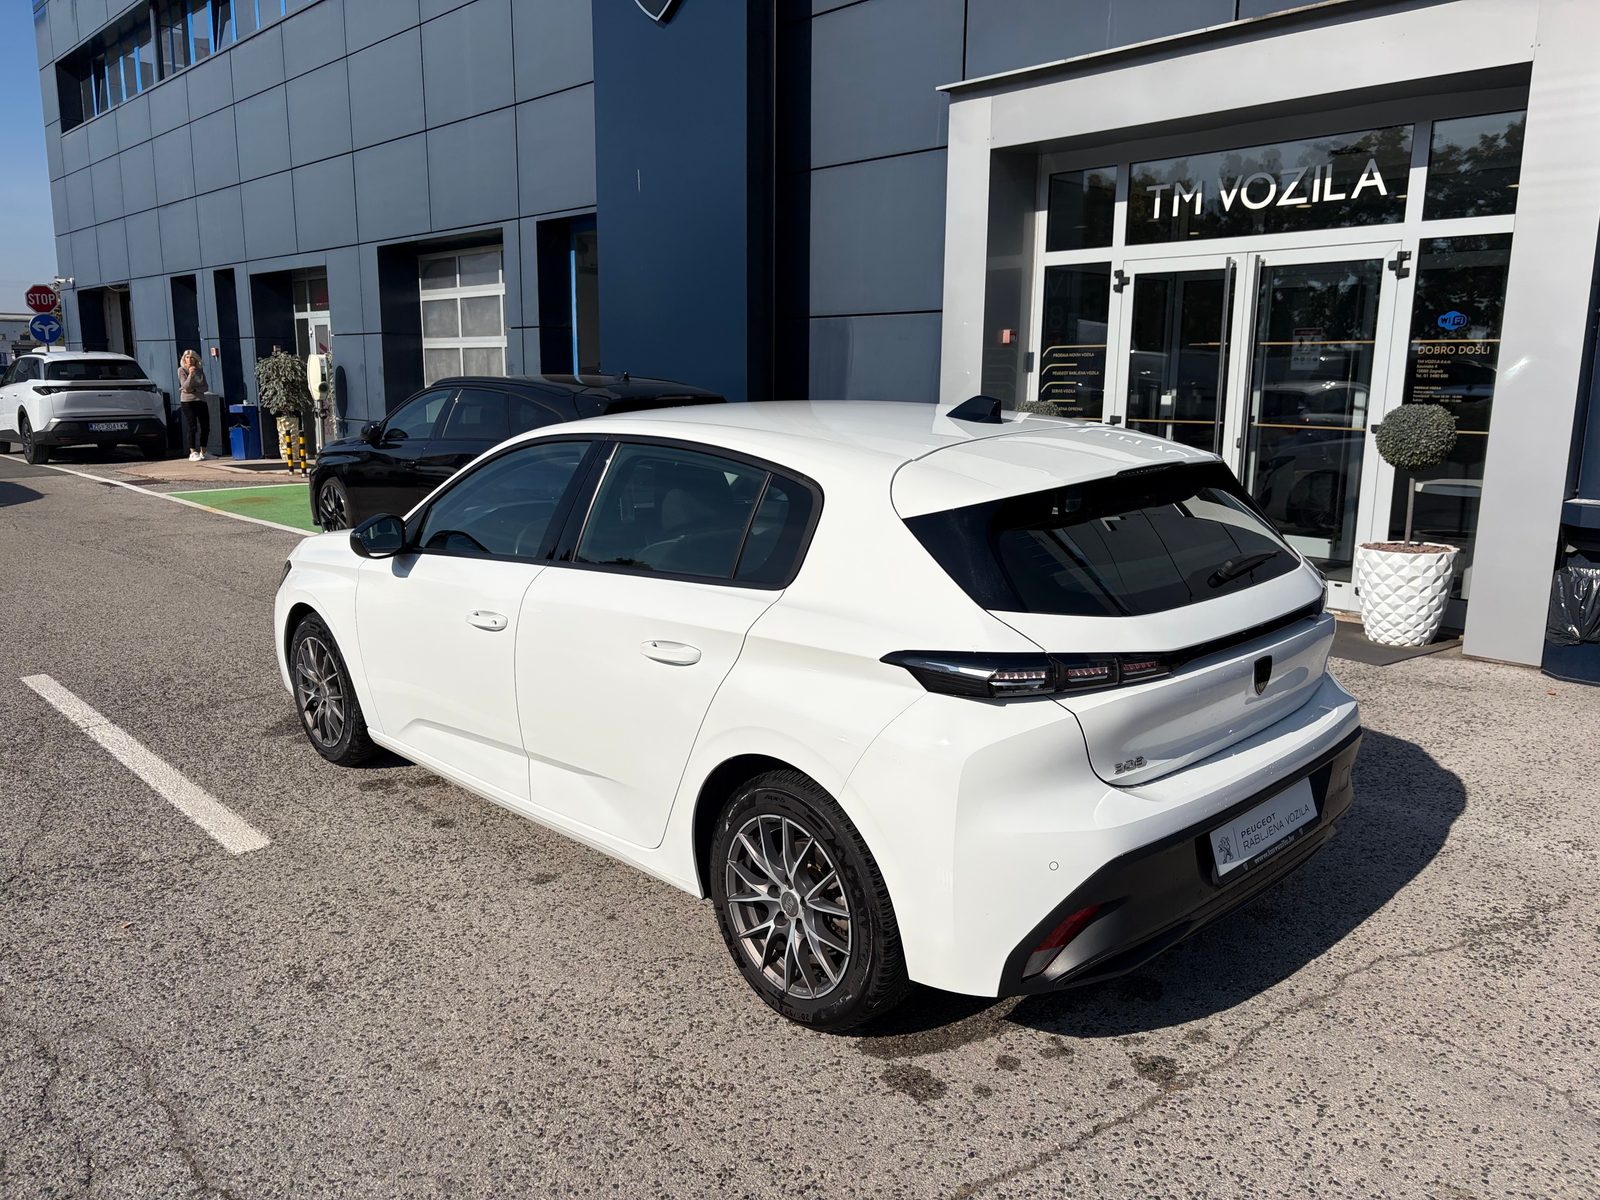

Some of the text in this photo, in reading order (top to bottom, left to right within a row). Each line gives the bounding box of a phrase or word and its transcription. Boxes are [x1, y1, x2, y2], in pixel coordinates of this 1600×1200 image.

[1146, 158, 1388, 219] TM VOZILA
[28, 294, 55, 305] STOP
[1417, 344, 1490, 355] DOBRO DOŠLI
[1114, 756, 1147, 775] 308
[1240, 812, 1276, 839] PEUGEOT
[1242, 804, 1310, 851] RABLJENA VOZILA
